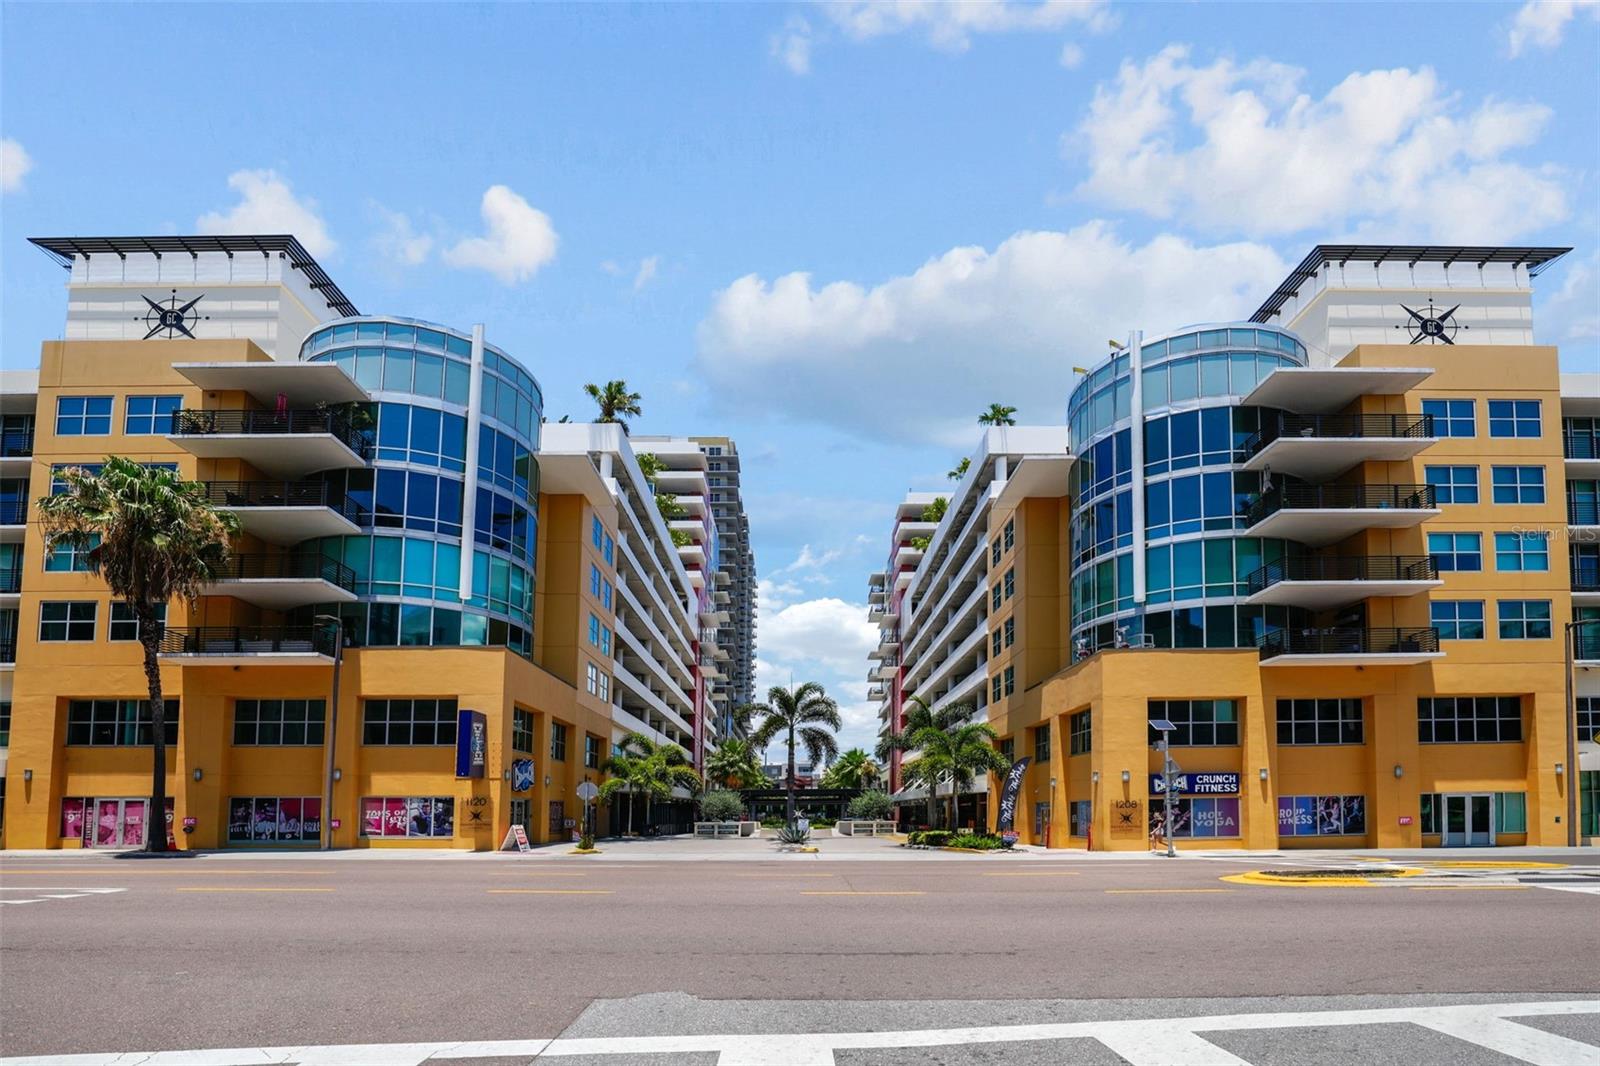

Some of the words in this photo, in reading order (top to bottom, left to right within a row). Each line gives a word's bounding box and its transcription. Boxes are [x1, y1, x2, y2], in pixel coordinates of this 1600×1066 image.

[1196, 774, 1236, 784] CRUNCH
[1194, 783, 1237, 793] FITNESS
[466, 797, 487, 806] 1120
[1115, 800, 1137, 808] 1208
[1198, 811, 1223, 820] HOT
[1279, 808, 1306, 818] ROUP
[1194, 817, 1234, 826] YOGA
[1279, 815, 1313, 825] ITNESS
